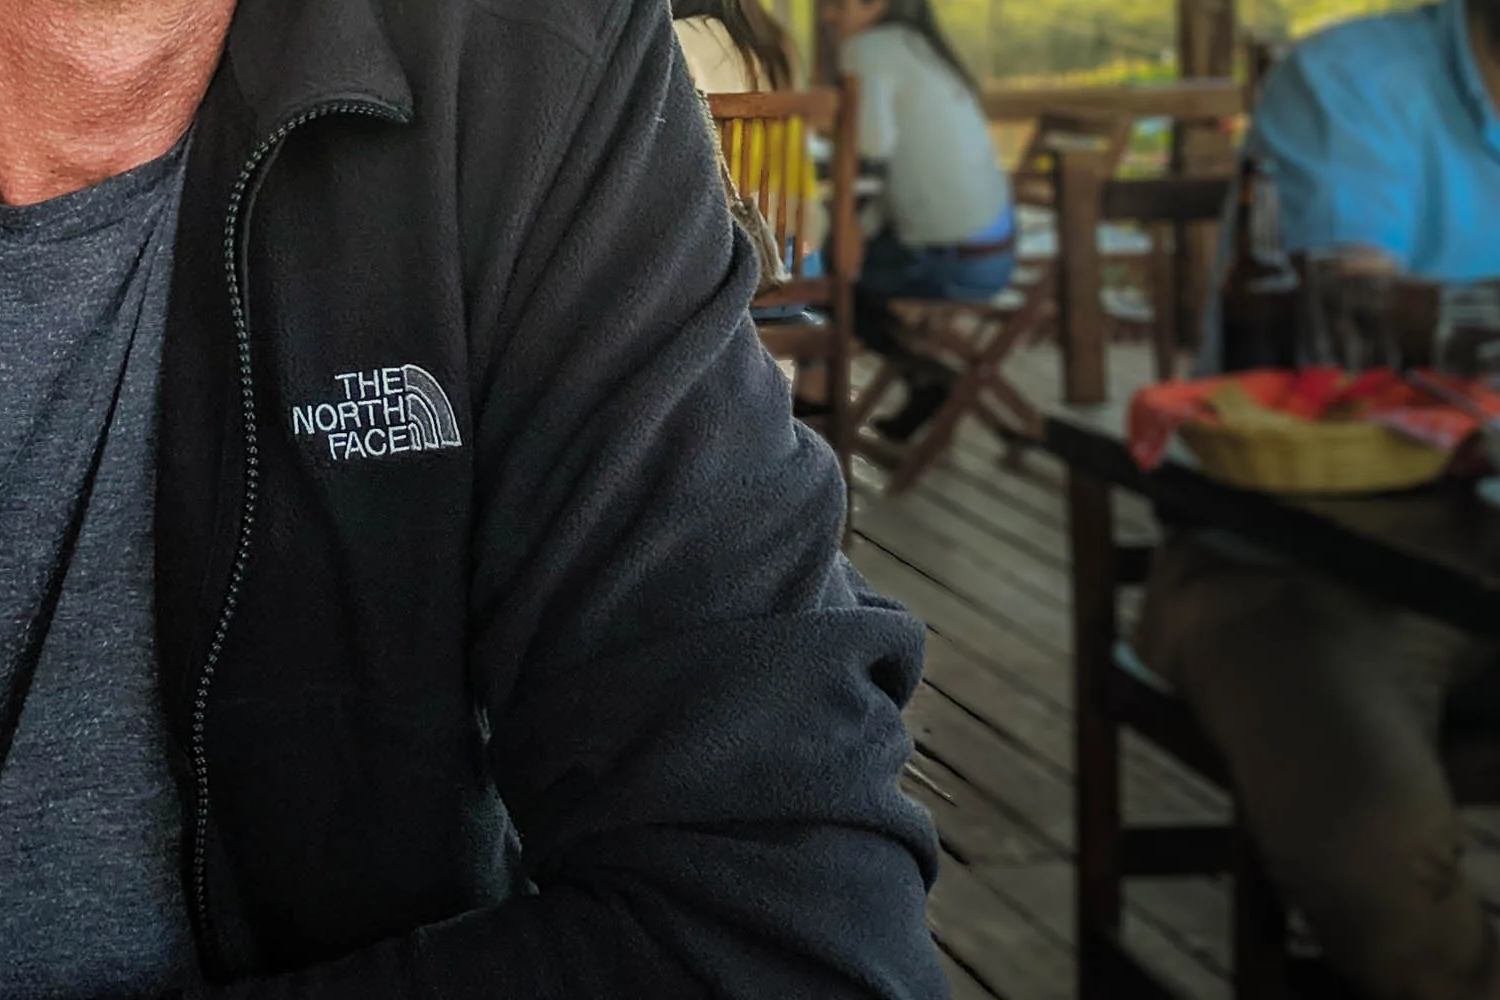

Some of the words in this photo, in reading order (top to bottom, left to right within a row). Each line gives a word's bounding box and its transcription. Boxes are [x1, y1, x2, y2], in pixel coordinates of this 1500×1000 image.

[334, 367, 404, 400] THE
[292, 396, 406, 436] NORTH
[327, 425, 409, 460] FACE
